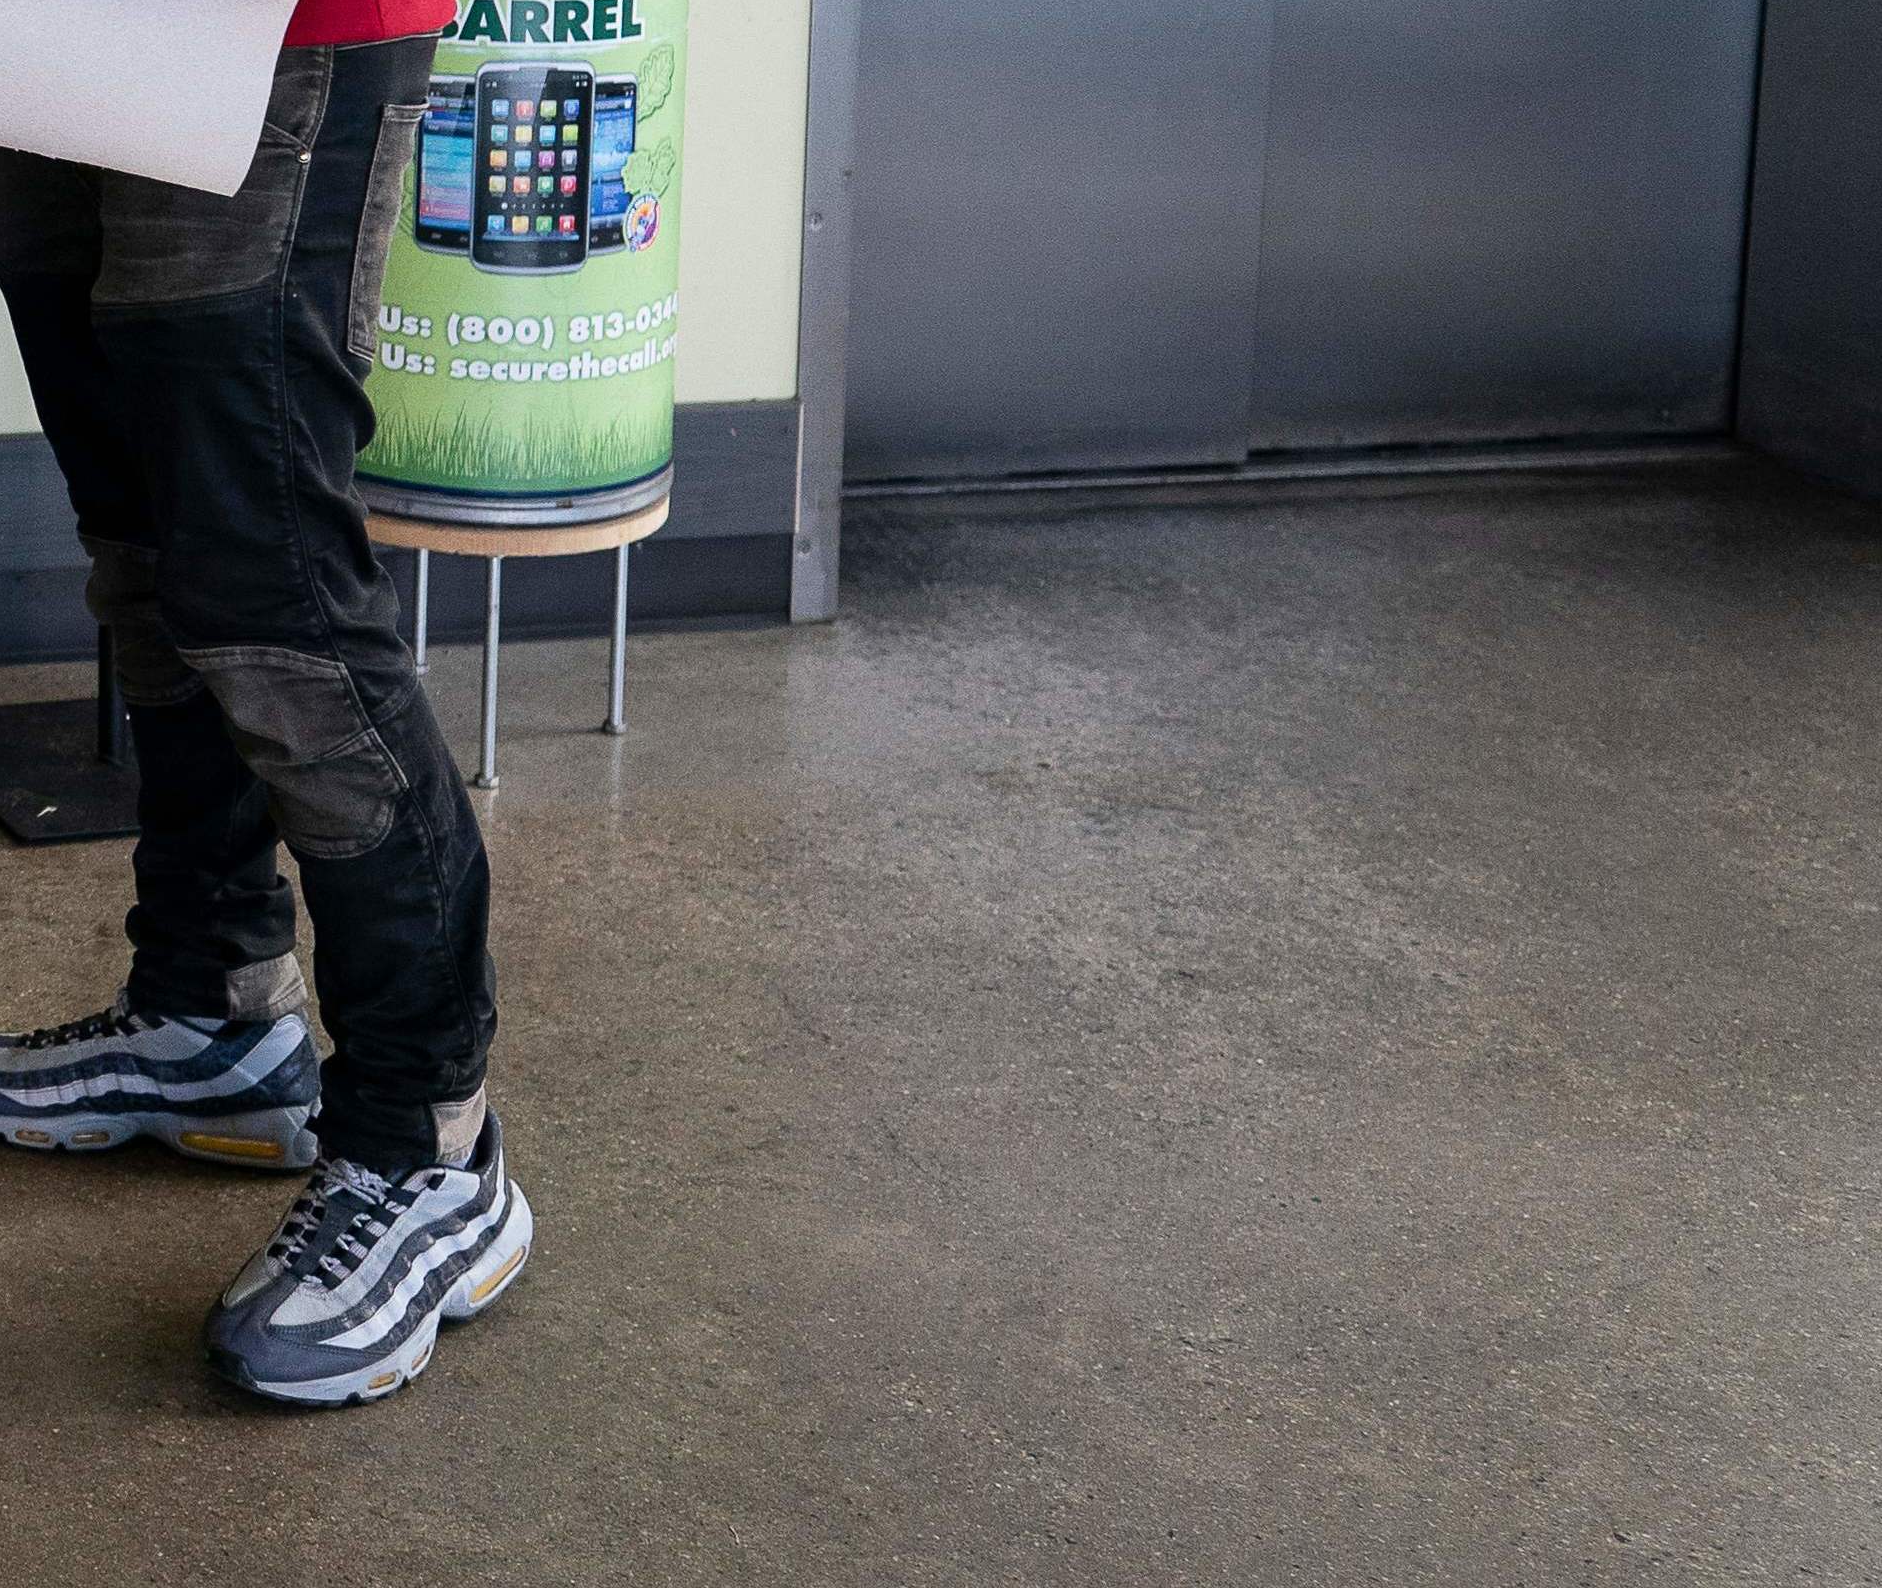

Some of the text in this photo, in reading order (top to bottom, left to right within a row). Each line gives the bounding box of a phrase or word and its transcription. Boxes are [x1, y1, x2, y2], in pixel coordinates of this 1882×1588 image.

[378, 305, 433, 339] Us:
[447, 312, 555, 351] (800)
[381, 342, 437, 375] Us:
